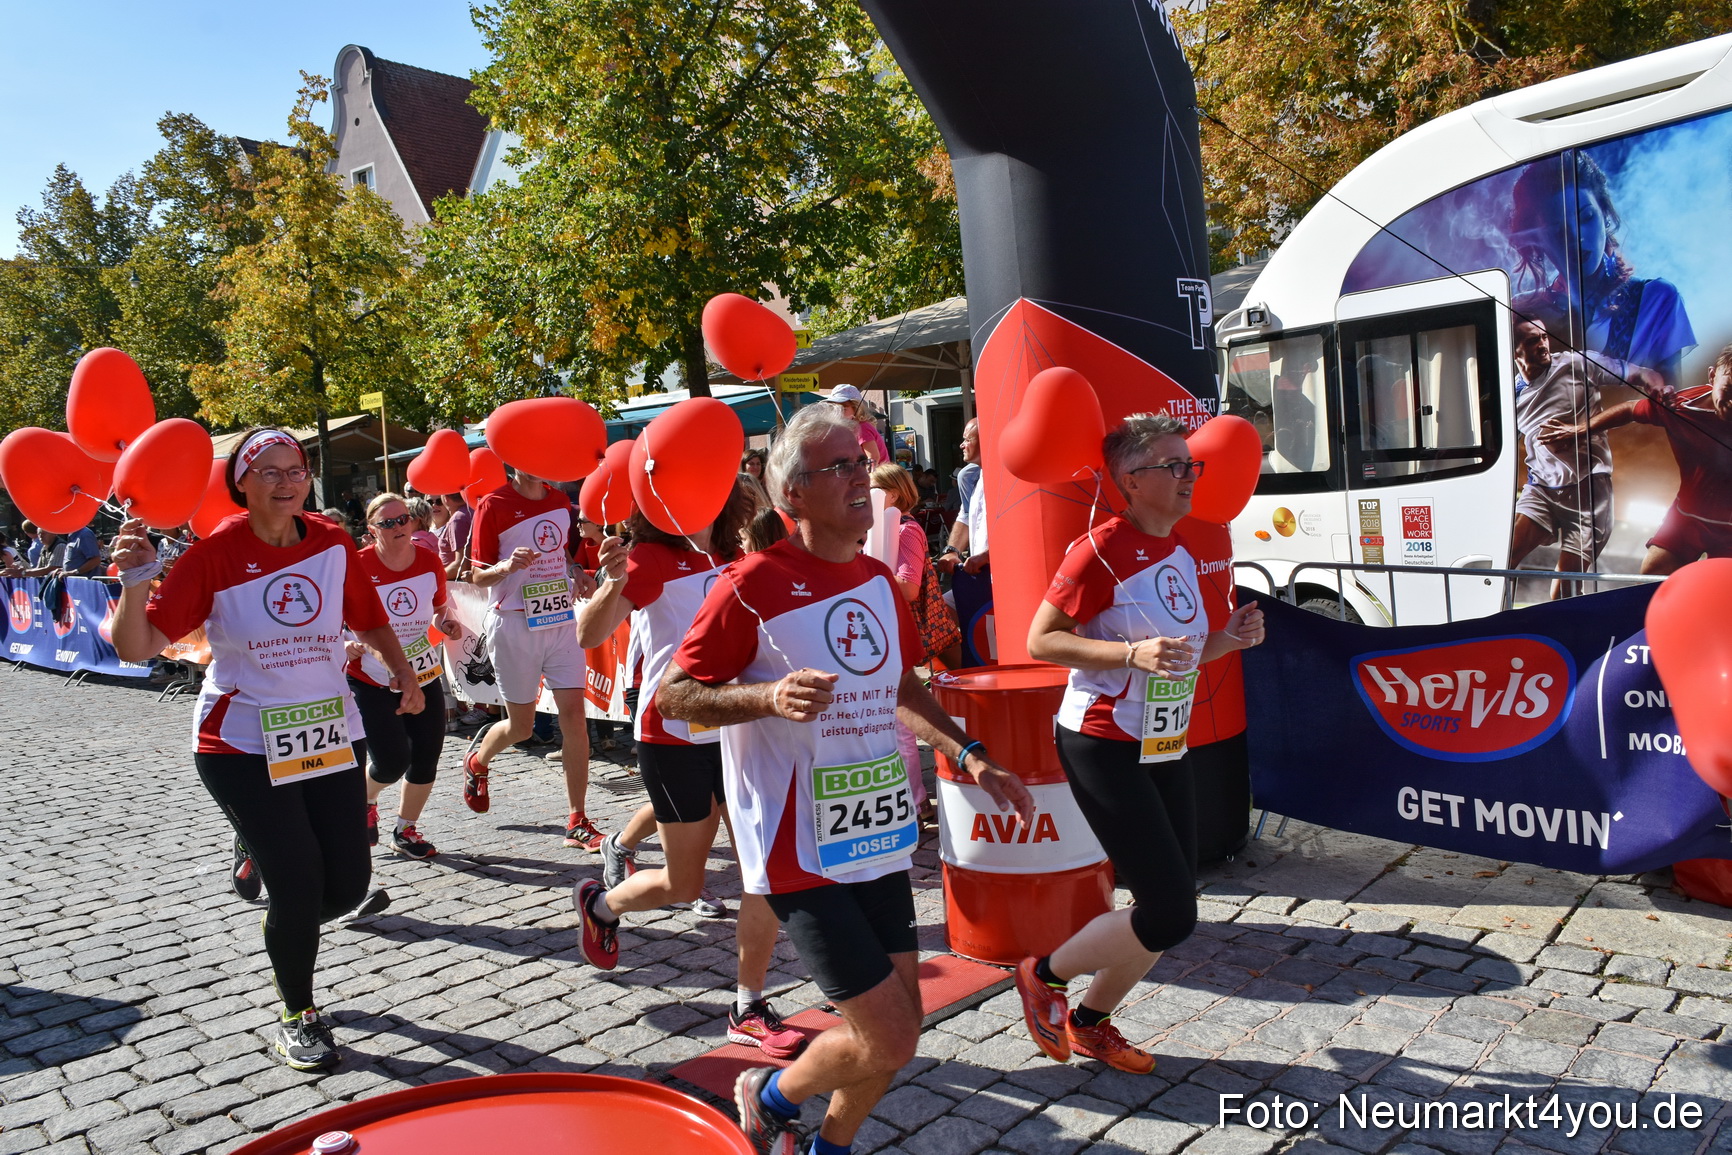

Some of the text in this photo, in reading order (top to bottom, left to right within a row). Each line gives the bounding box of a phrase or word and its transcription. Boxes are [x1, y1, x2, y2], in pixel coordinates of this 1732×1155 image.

[1167, 397, 1216, 415] THE NEXT
[1360, 501, 1378, 510] TOP
[1404, 507, 1429, 516] GREAT
[1361, 519, 1380, 528] 2018
[1404, 515, 1429, 523] PLACE
[1419, 522, 1430, 530] TO
[1405, 541, 1433, 552] 2018
[526, 582, 566, 596] BOCK
[530, 594, 569, 615] 2456
[536, 613, 569, 625] RÜDIGER
[248, 634, 339, 651] LAUFEN MIT HERZ
[259, 652, 271, 660] Dr.
[272, 648, 292, 658] Heck
[1624, 645, 1651, 665] ST
[261, 655, 331, 670] Leistungsdiagnostik
[417, 670, 436, 682] STIN
[585, 665, 612, 695] raun
[862, 689, 881, 701] MIT
[1362, 657, 1554, 728] Hervis
[269, 702, 338, 727] BOCK
[820, 713, 835, 722] Dr.
[837, 709, 859, 720] Heck
[866, 708, 877, 717] Dr.
[878, 706, 895, 716] Rösc
[1400, 711, 1462, 733] SPORTS
[276, 723, 341, 757] 5124
[301, 757, 324, 770] INA
[824, 757, 904, 793] BOCK
[829, 788, 910, 836] 2455
[1397, 786, 1465, 828] GET
[970, 807, 1060, 844] AVIA
[848, 833, 901, 858] JOSEF
